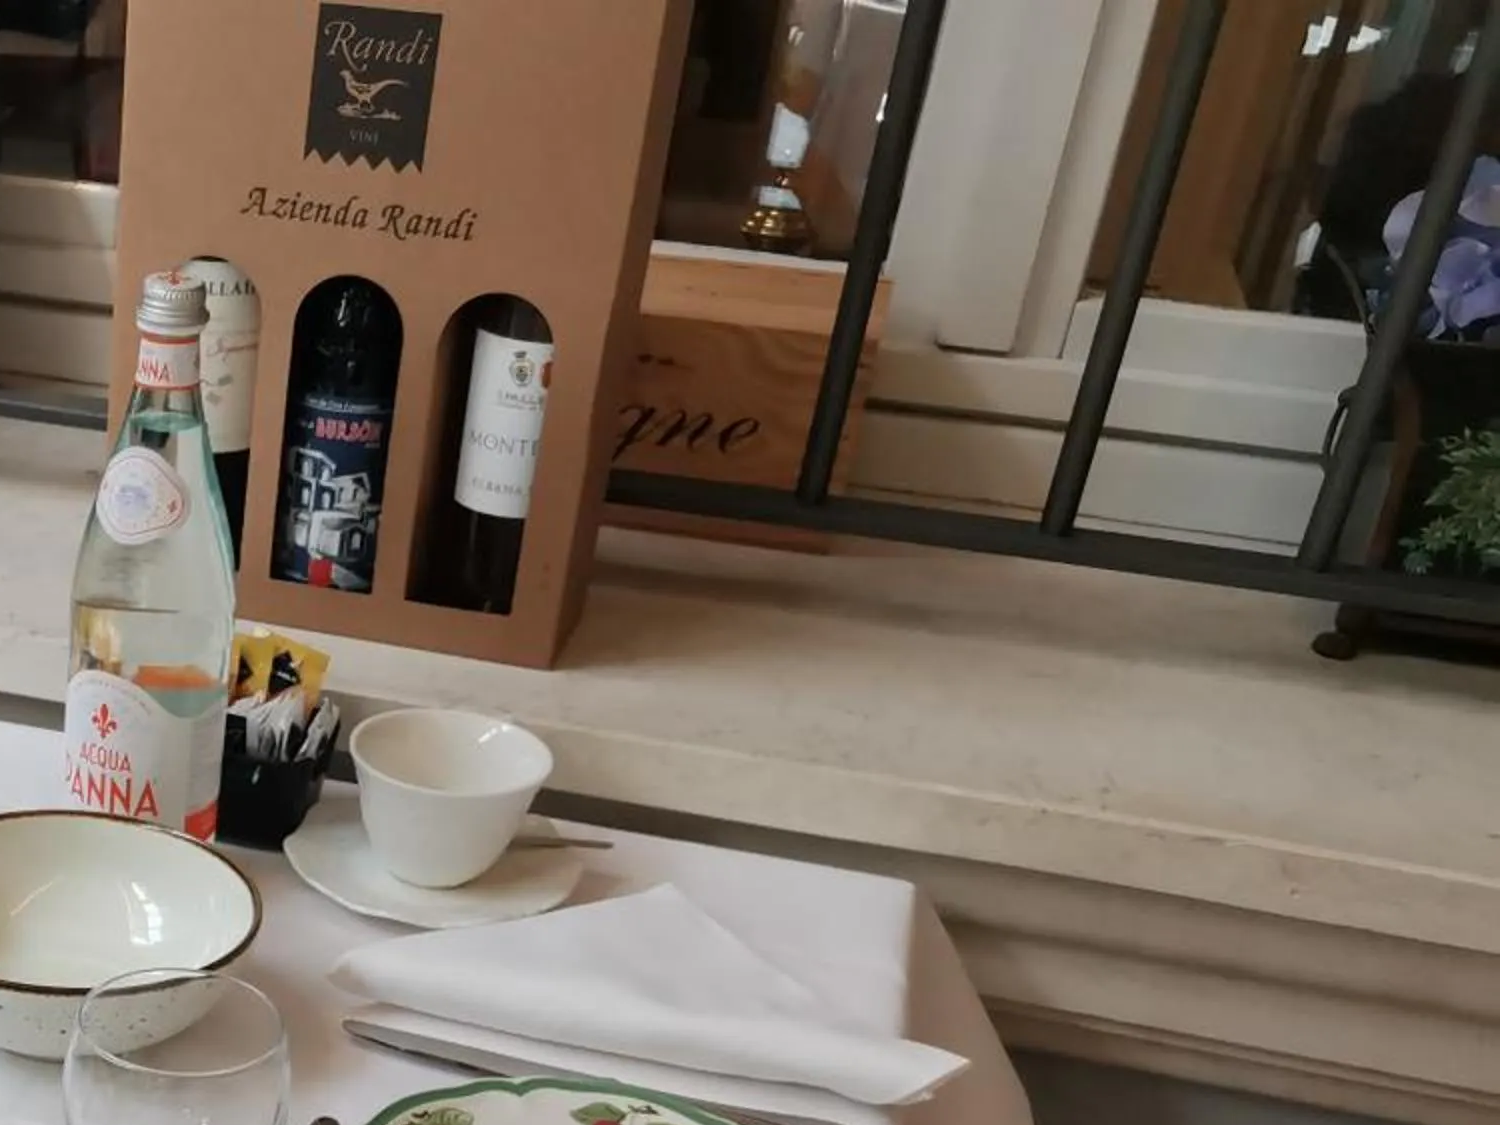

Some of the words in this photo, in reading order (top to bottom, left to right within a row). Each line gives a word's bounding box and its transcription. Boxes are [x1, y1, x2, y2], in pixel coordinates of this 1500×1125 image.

[324, 20, 433, 72] Randi
[240, 187, 369, 228] Azienda
[378, 204, 477, 241] Randi
[141, 360, 171, 382] NNA
[80, 742, 132, 774] ACQUA
